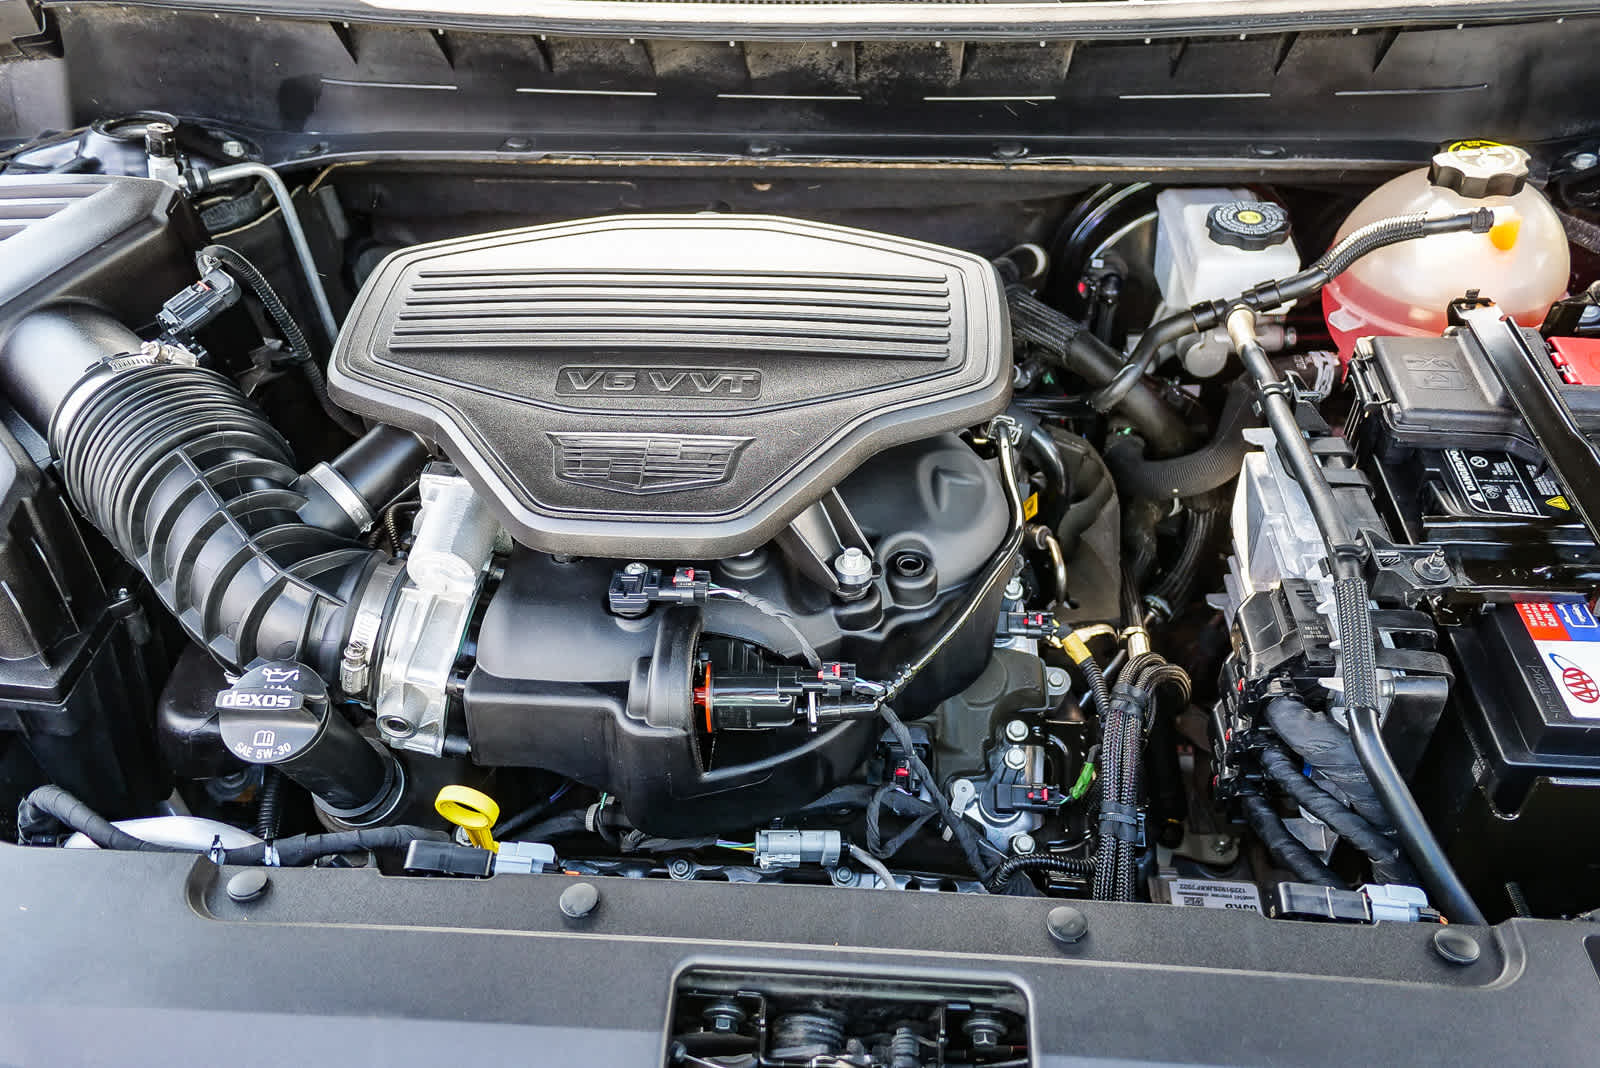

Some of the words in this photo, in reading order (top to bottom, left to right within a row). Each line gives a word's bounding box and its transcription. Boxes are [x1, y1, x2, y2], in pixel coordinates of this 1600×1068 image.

[567, 371, 637, 391] V6
[648, 371, 755, 393] VVT
[222, 690, 294, 708] dexos
[234, 742, 253, 758] SAE
[255, 742, 292, 759] 5W-30
